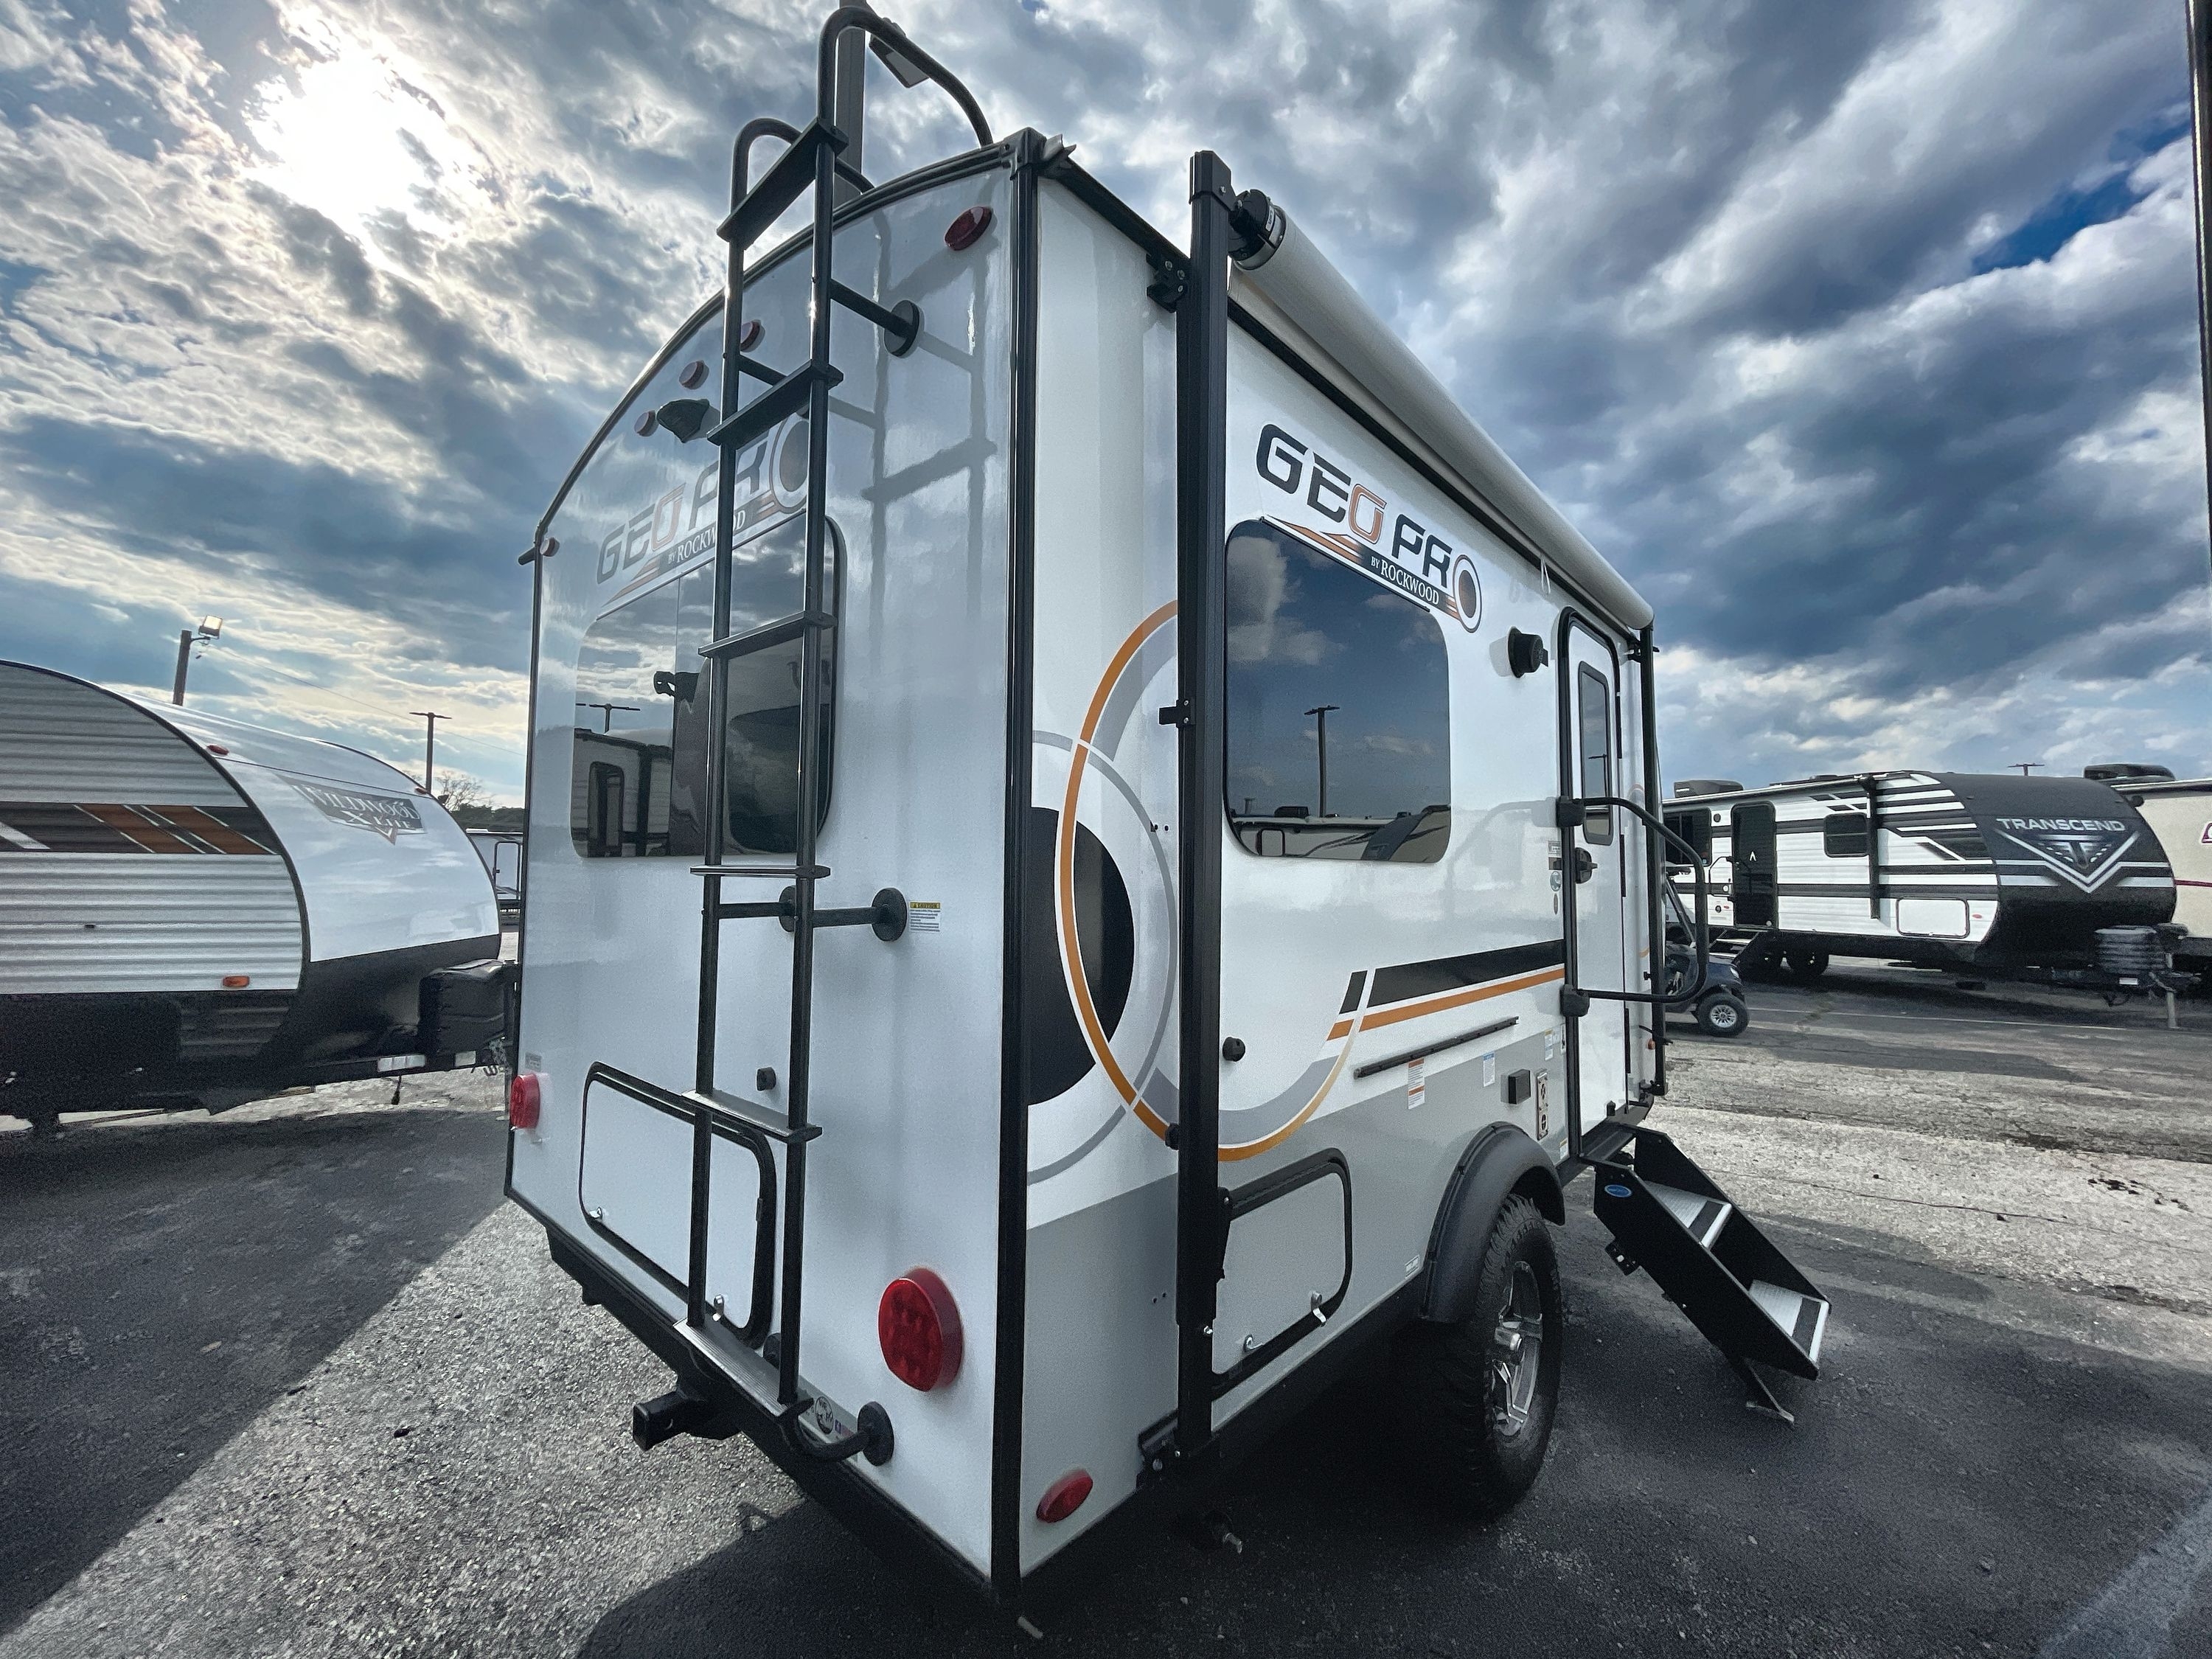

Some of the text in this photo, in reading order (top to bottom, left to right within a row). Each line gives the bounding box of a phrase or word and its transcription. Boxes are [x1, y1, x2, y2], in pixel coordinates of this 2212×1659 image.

[597, 483, 686, 585] GEO
[1256, 423, 1482, 633] GEO PRO
[668, 550, 677, 564] BY
[1371, 556, 1439, 605] BY ROCKWOOD
[291, 784, 421, 820] WILDWOOD
[1996, 818, 2126, 832] TRANSCEND
